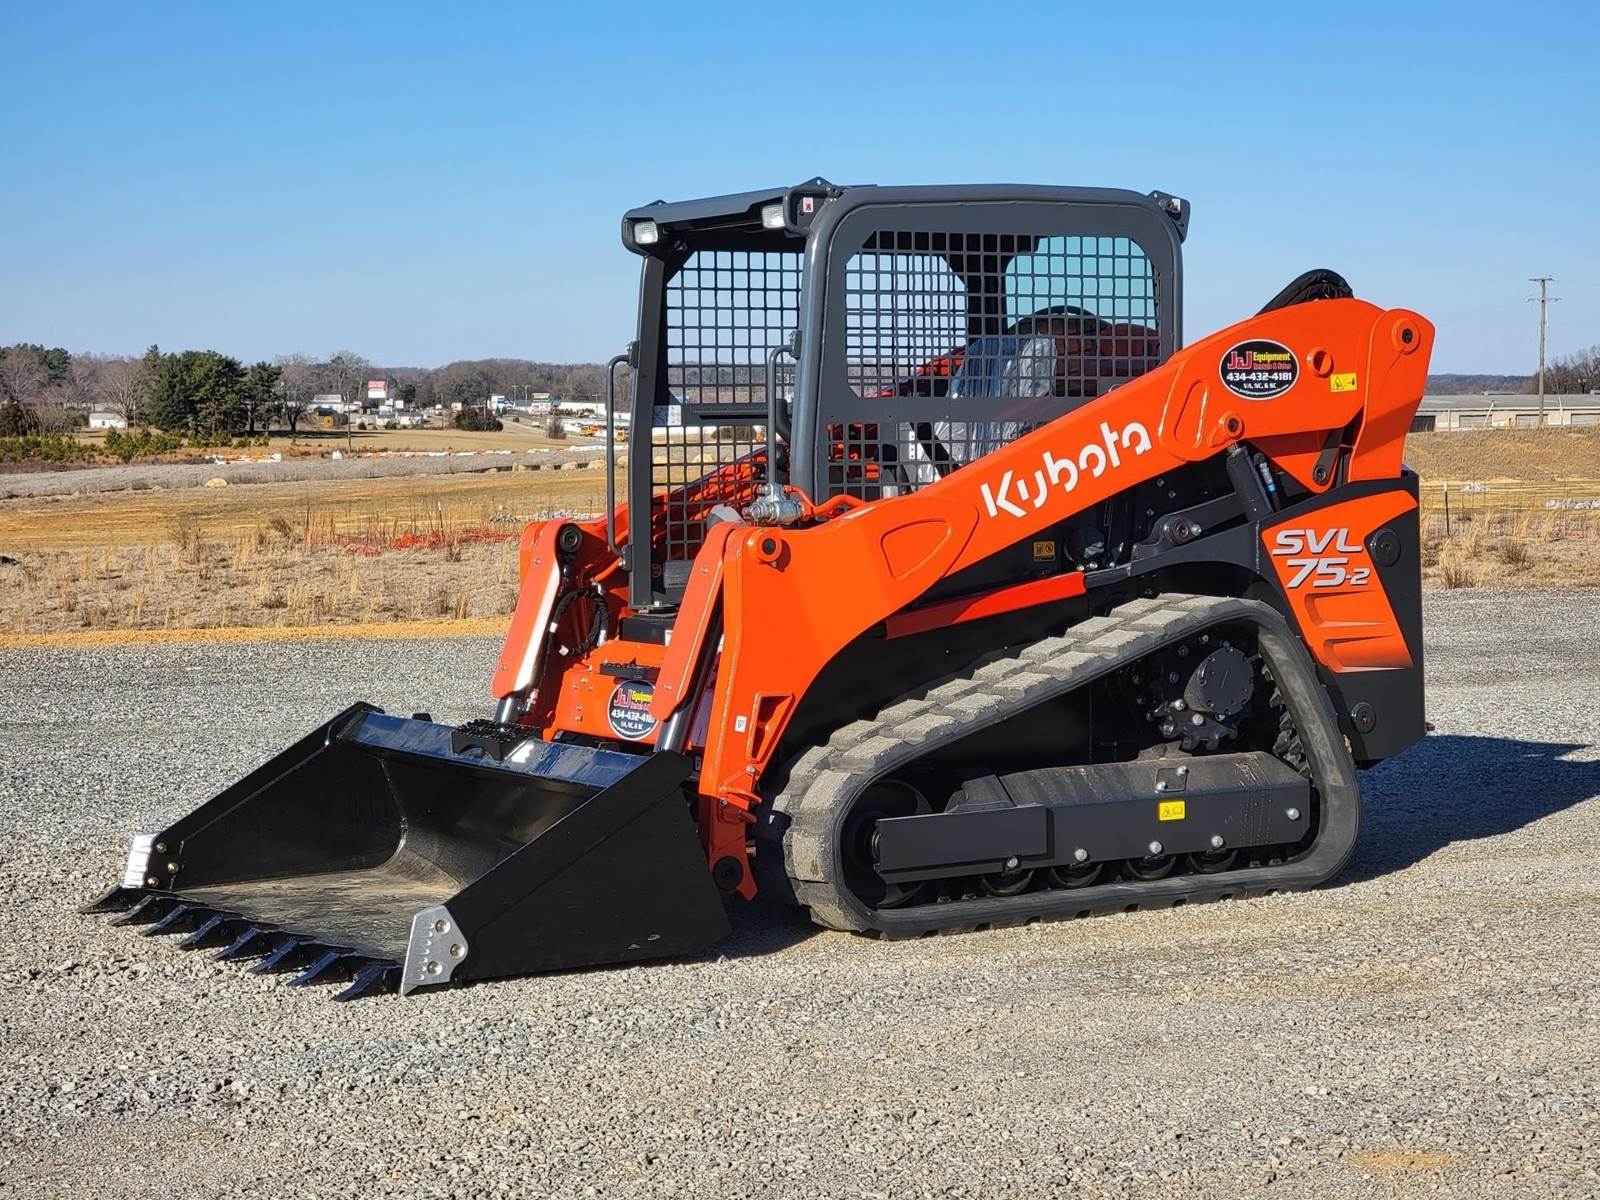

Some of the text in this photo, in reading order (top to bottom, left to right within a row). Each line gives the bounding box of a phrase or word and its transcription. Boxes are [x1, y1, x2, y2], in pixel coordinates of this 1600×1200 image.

[1253, 351, 1291, 363] Equipment
[1226, 372, 1292, 381] 434-432-4181
[979, 421, 1152, 519] Kubota
[1272, 528, 1364, 555] SVL
[1286, 557, 1370, 589] 75-2
